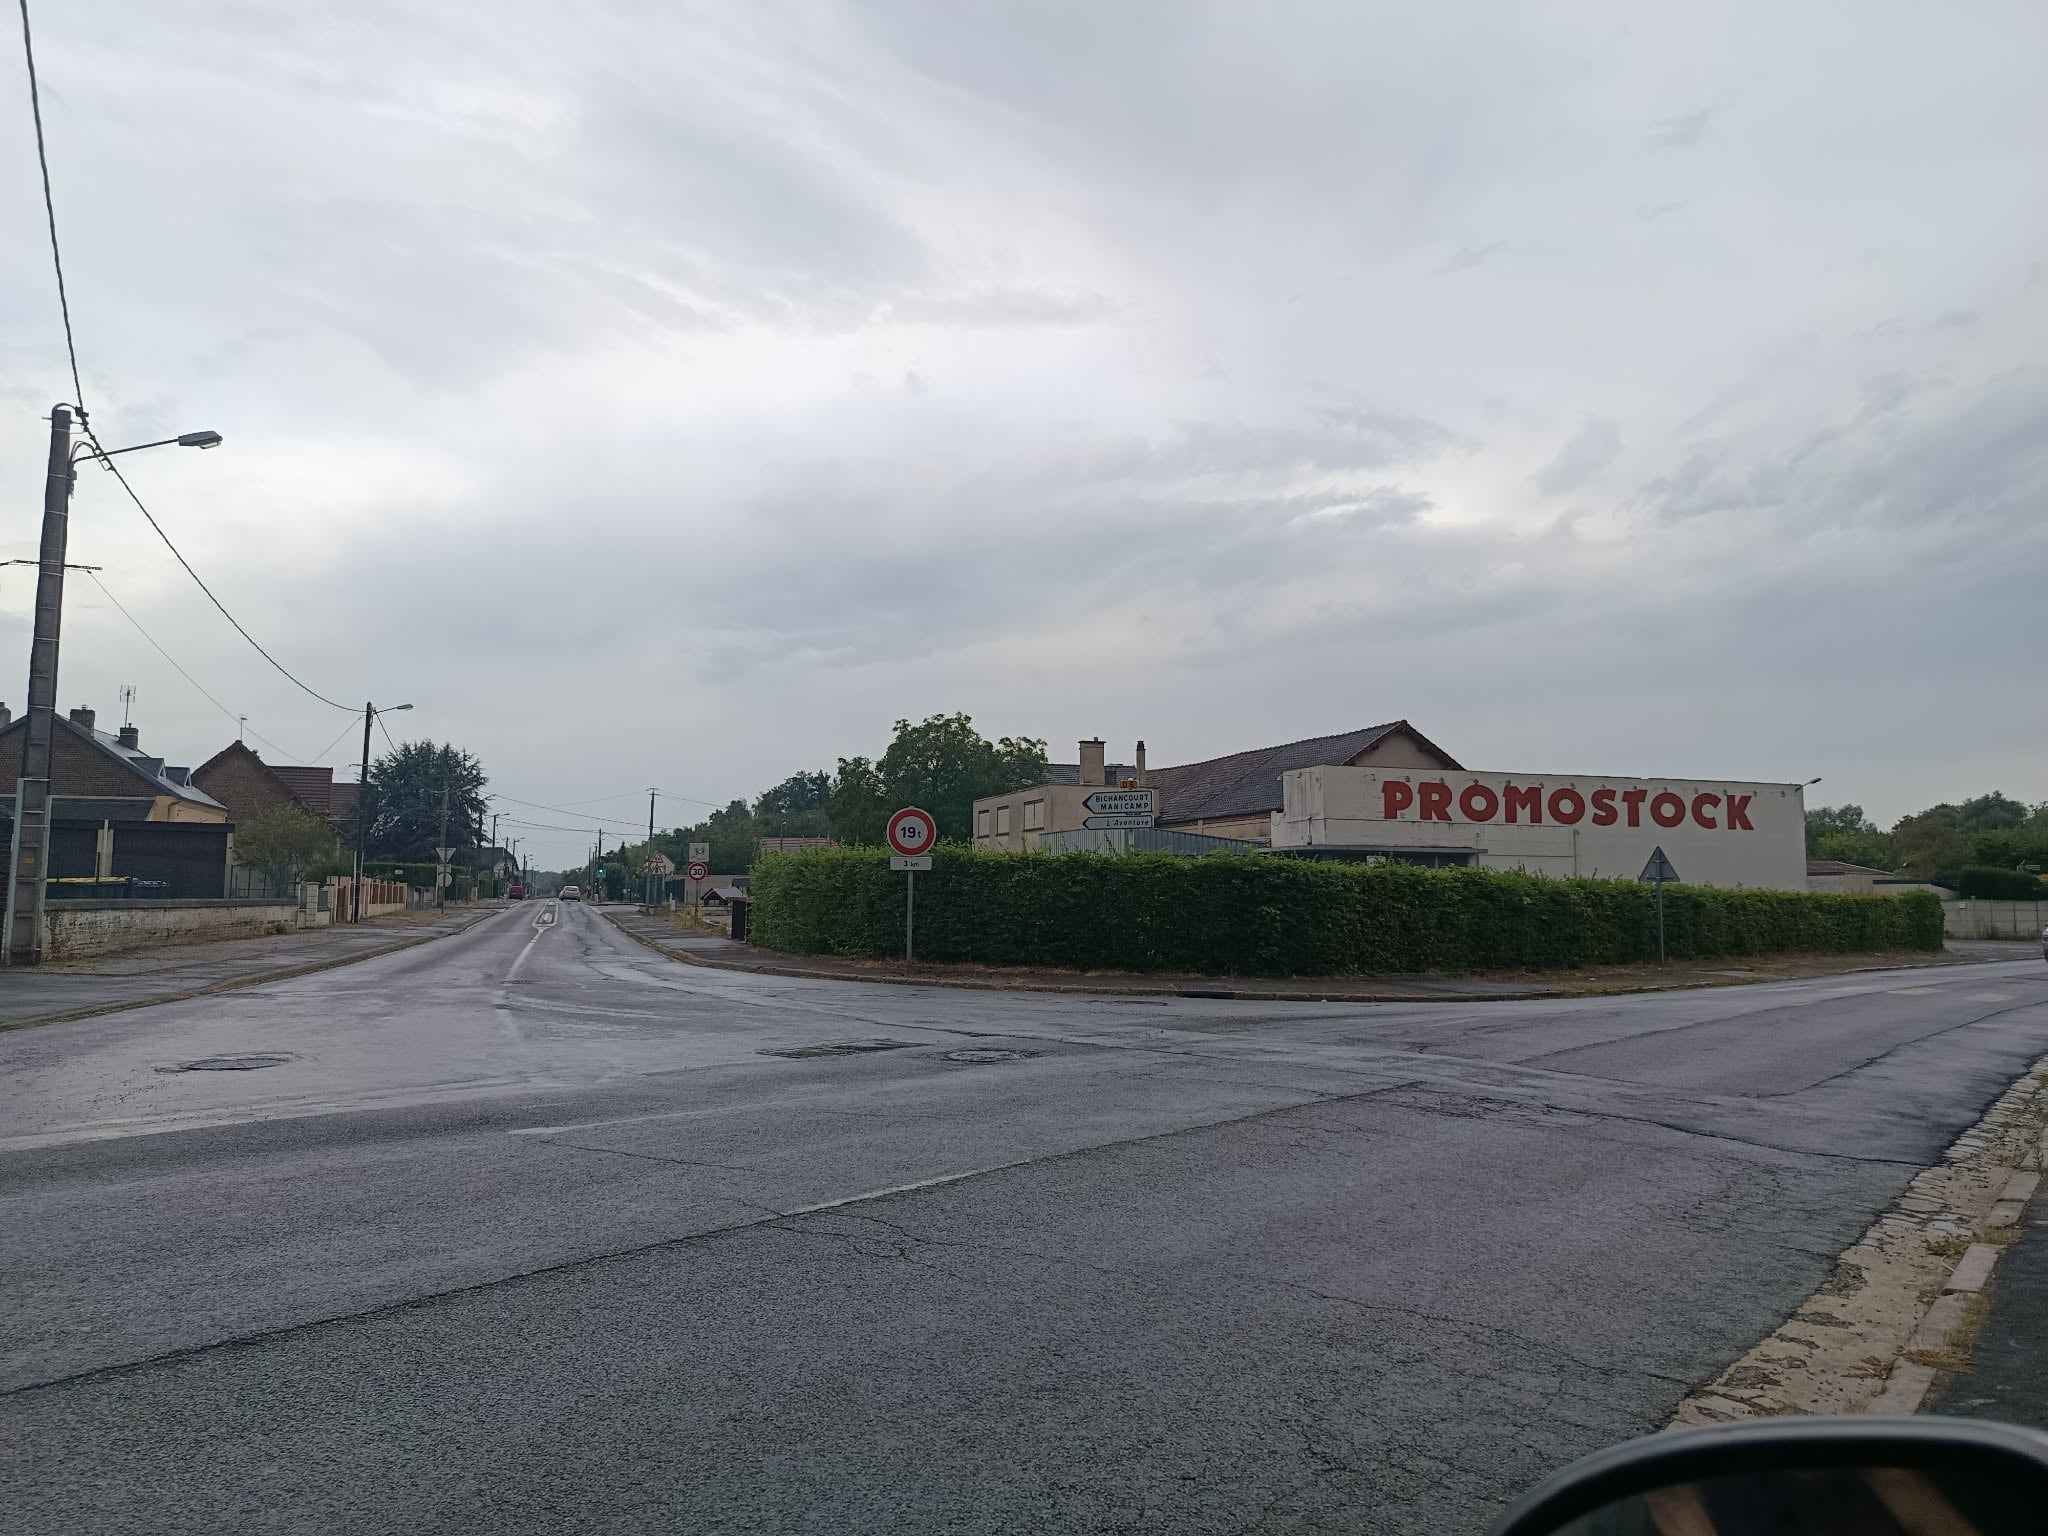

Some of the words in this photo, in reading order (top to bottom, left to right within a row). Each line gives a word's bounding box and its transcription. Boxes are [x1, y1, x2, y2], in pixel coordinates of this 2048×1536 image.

[1095, 794, 1149, 803] BICHANCOURT
[1100, 802, 1149, 810] MANICAMP
[1381, 780, 1755, 831] PROMOSTOCK
[692, 868, 703, 876] 30
